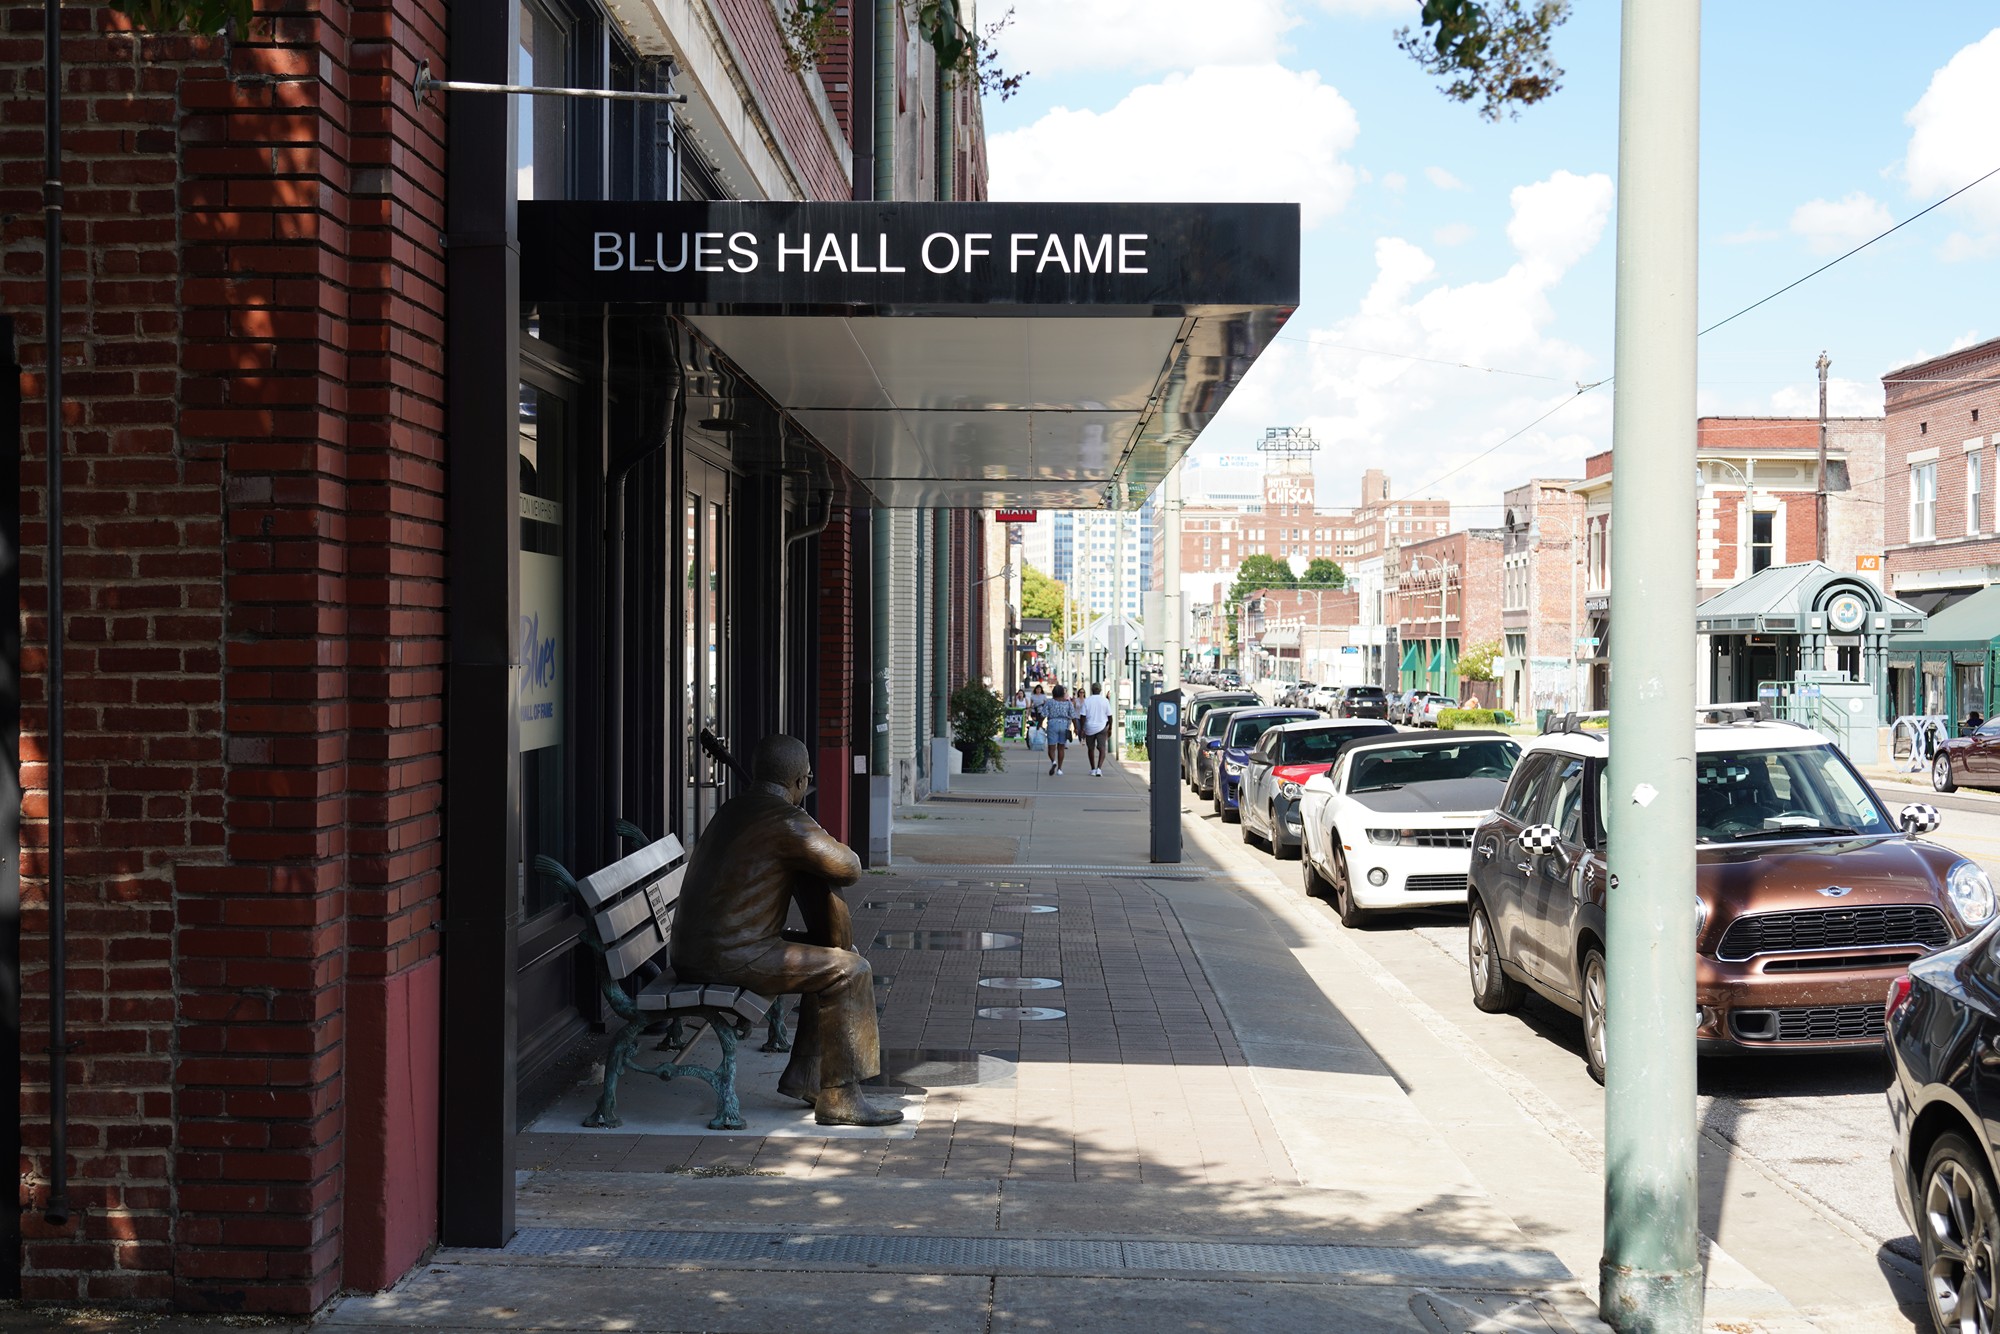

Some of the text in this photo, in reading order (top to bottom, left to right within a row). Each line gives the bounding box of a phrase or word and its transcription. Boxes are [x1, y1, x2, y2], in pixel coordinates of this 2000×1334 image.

[594, 231, 1148, 273] BLUES HALL OF FAME
[1267, 479, 1293, 488] HOTEL
[1268, 488, 1314, 504] CHISCA
[520, 610, 555, 696] Blues
[520, 705, 533, 722] HALL
[540, 702, 553, 719] FAME
[1163, 704, 1174, 722] P
